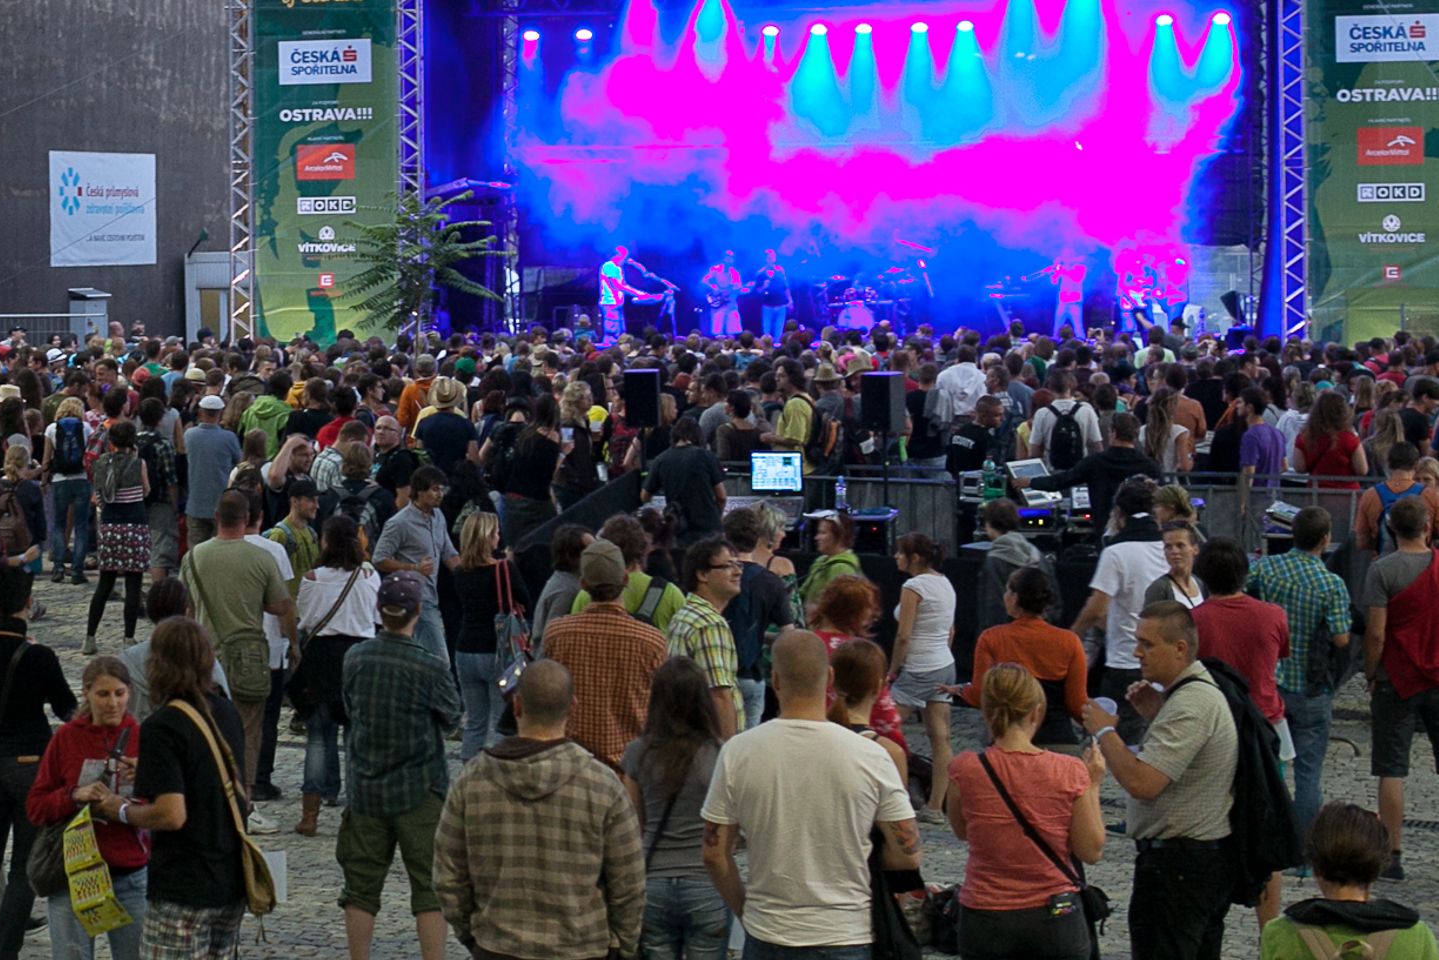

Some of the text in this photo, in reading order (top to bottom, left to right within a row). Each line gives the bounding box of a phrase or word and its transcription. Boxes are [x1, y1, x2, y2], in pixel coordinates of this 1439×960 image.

[1349, 23, 1407, 40] ČESKÁ
[1349, 40, 1426, 53] SPOŘITELNA
[291, 47, 341, 63] ČESKÁ
[291, 64, 357, 75] SPOŘITELNA
[280, 107, 373, 122] OSTRAVA!!!
[1359, 231, 1426, 243] VÍTKOVICE
